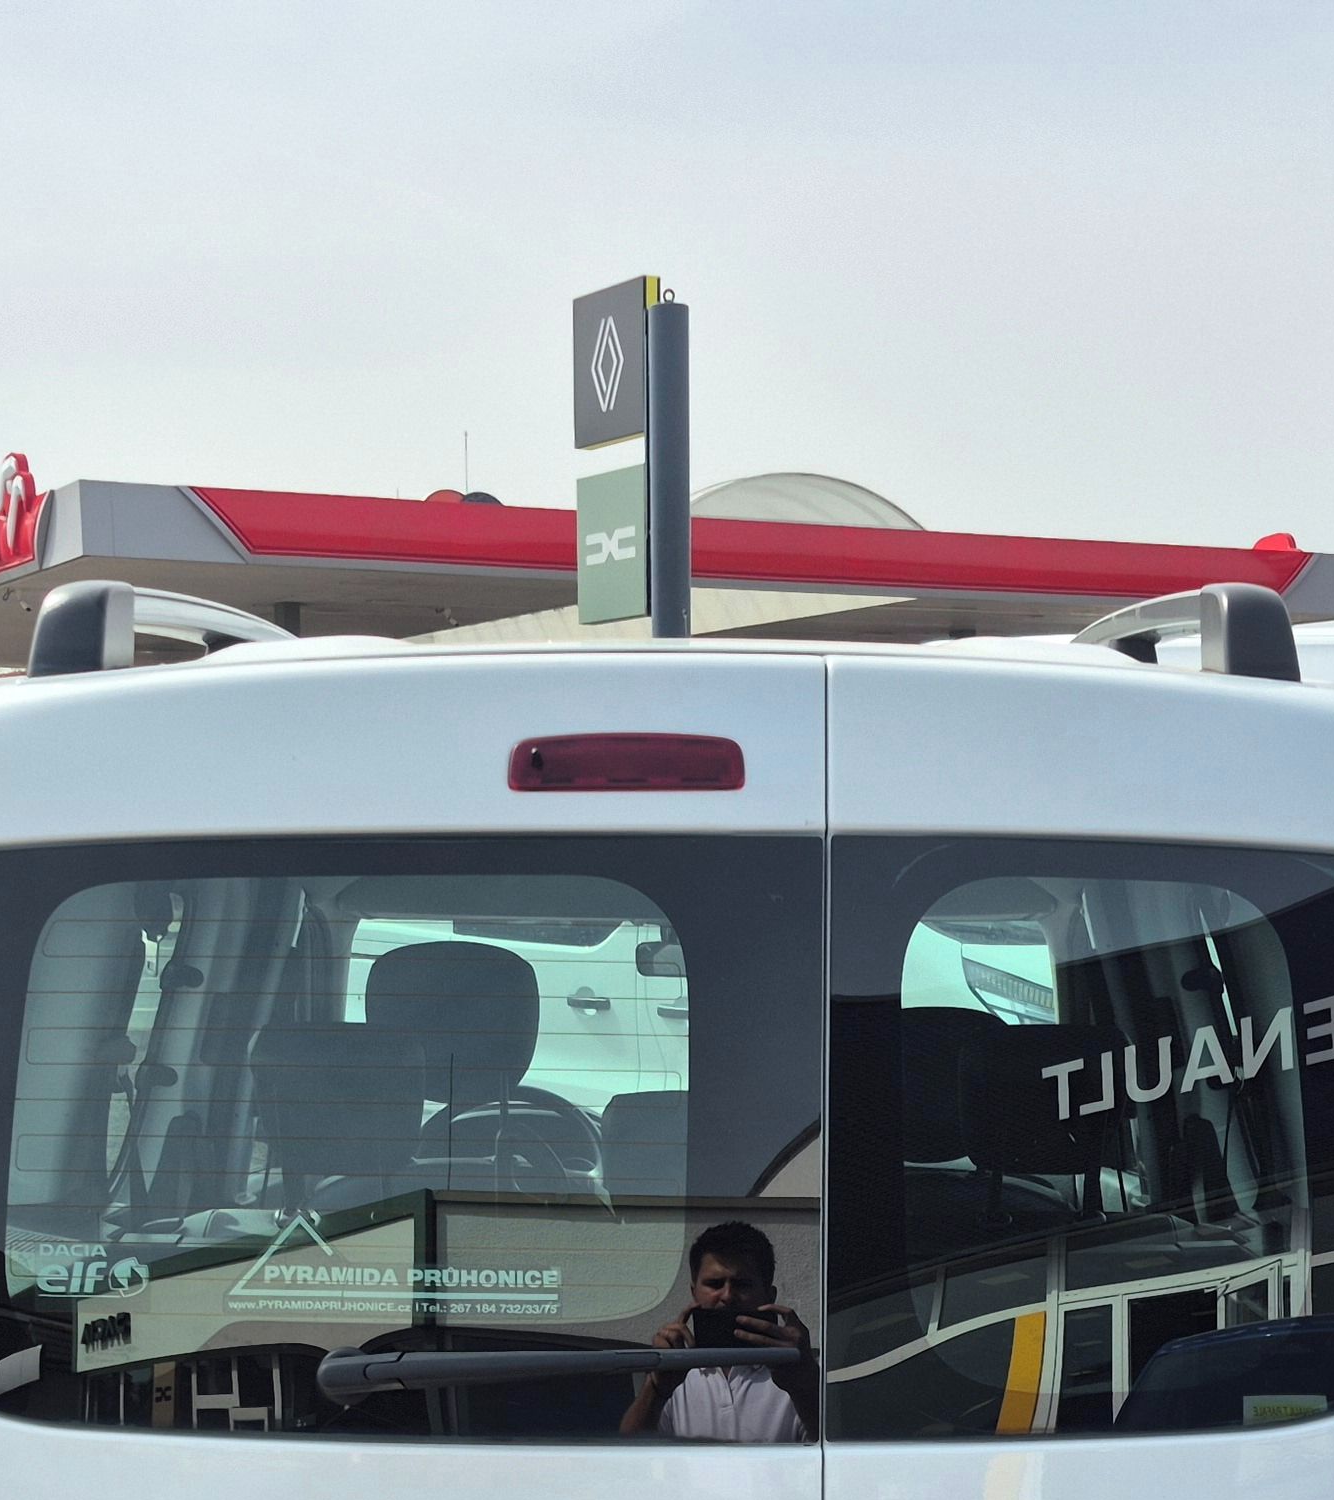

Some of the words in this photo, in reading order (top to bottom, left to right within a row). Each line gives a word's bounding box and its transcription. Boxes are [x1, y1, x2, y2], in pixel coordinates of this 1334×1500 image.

[39, 1243, 108, 1257] DACIA
[36, 1261, 108, 1293] elf
[264, 1265, 398, 1286] PYRAMIDA
[408, 1267, 561, 1289] PRŮHONICE
[421, 1301, 447, 1313] Tel.:
[450, 1302, 472, 1313] 267
[475, 1303, 496, 1313] 184
